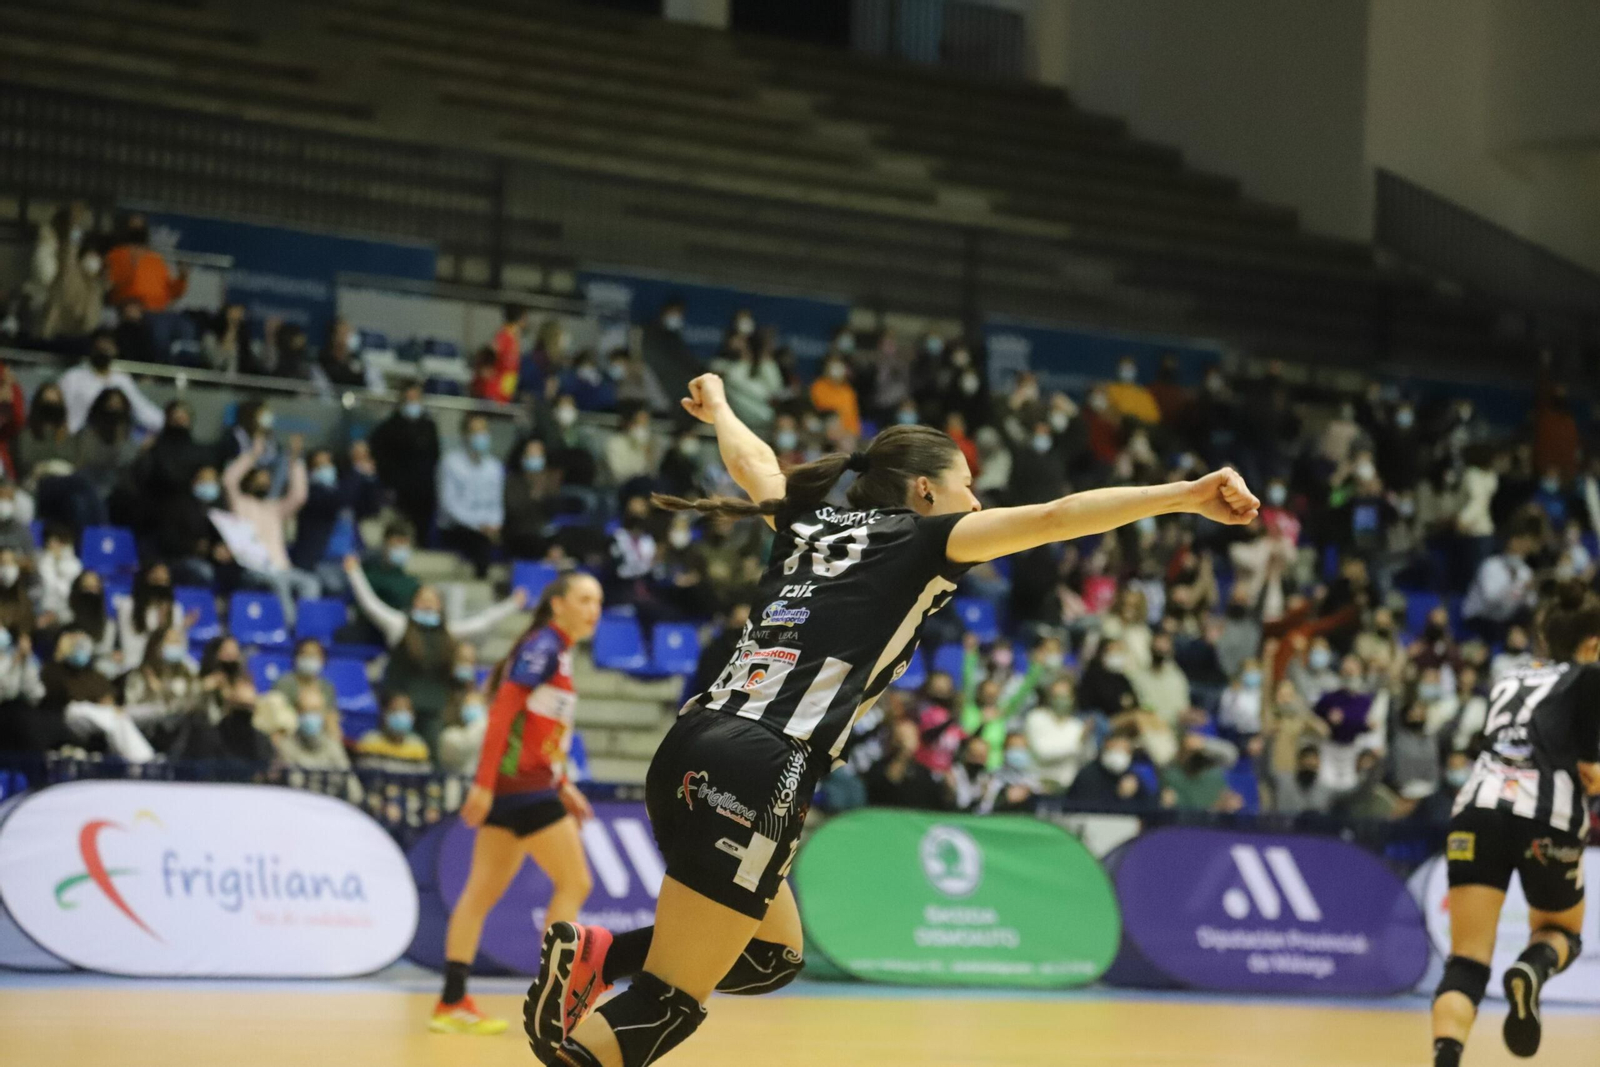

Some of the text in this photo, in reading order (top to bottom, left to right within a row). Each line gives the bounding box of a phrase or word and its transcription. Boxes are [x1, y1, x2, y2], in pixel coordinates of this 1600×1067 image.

[1484, 674, 1560, 736] 27
[698, 783, 757, 821] frigiliana
[161, 850, 367, 912] frigiliana
